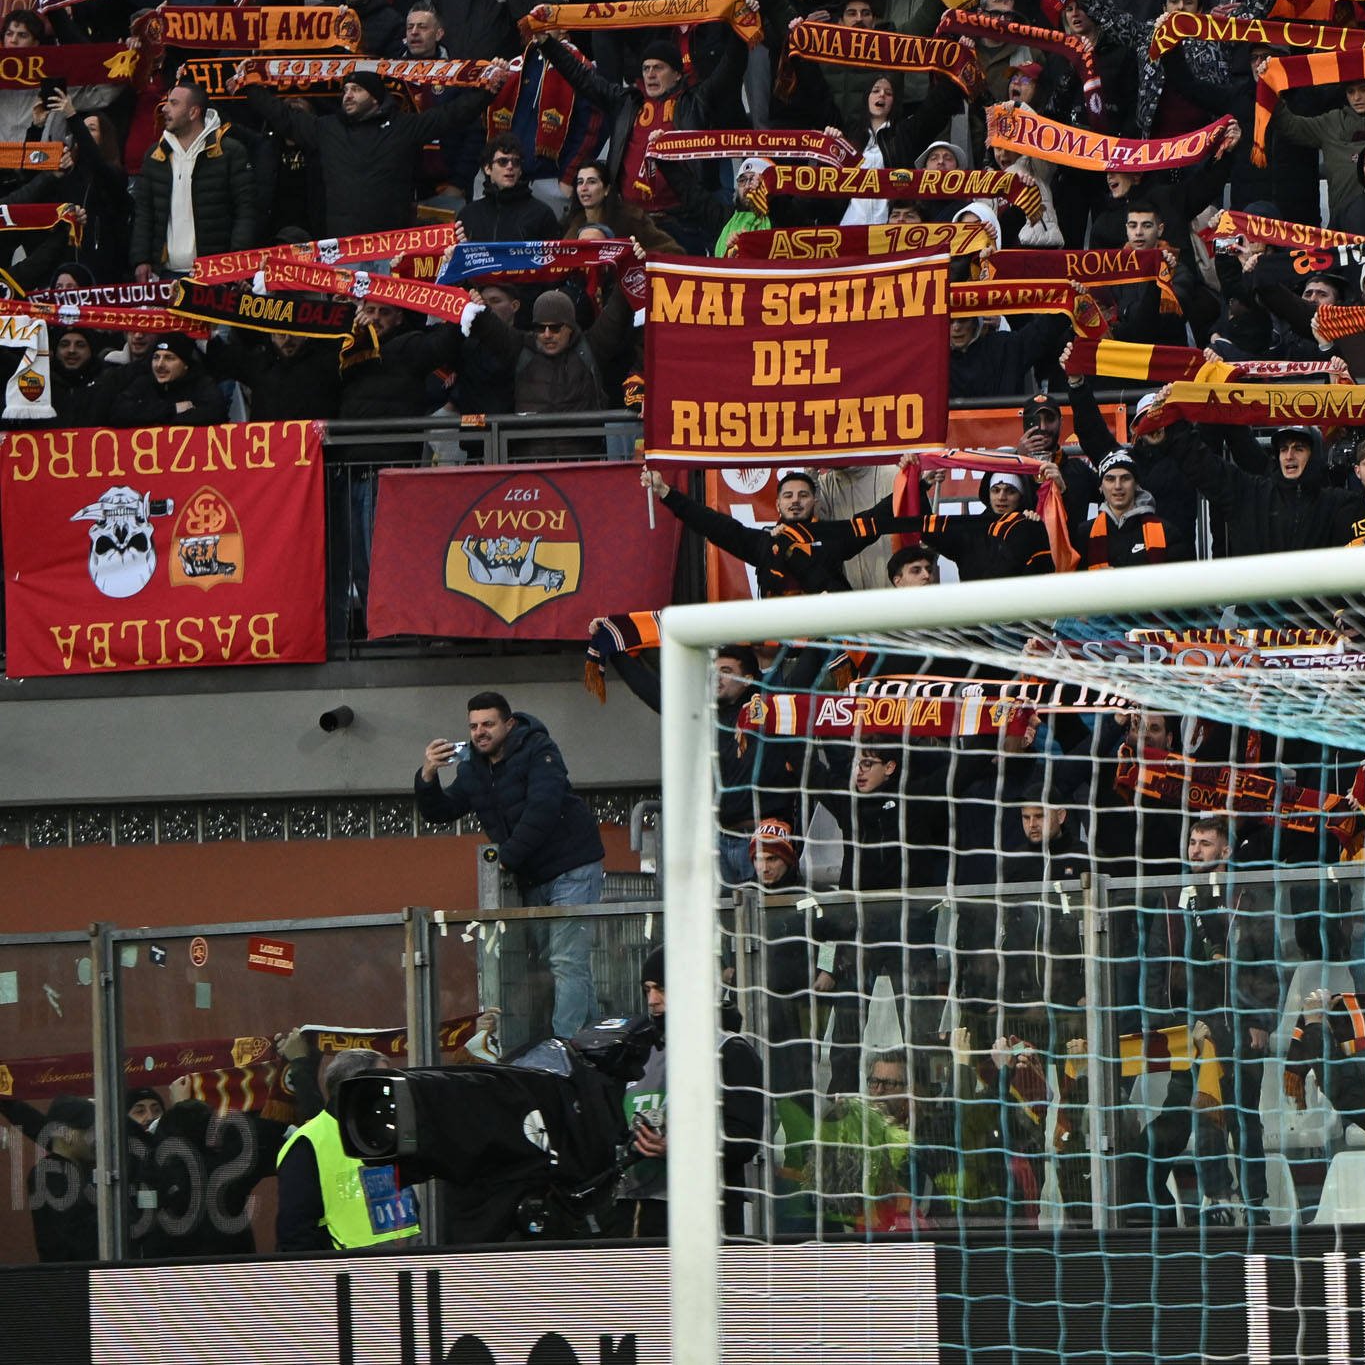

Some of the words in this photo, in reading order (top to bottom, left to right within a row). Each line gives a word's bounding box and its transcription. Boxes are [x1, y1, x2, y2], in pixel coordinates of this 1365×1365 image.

[165, 10, 243, 42] ROMA
[244, 8, 273, 39] TI
[278, 7, 334, 39] AMO
[584, 2, 618, 19] AS
[1155, 12, 1271, 55] ROMA
[850, 35, 882, 63] HA
[889, 38, 961, 70] VINTO
[278, 60, 353, 79] FORZA
[376, 61, 454, 83] ROMA
[721, 133, 756, 148] Ultrà
[759, 132, 794, 148] Curva
[797, 134, 824, 150] Sud
[1021, 114, 1111, 154] ROMA
[1126, 127, 1207, 165] AMO
[776, 163, 880, 193] FORZA
[917, 168, 1013, 195] ROMA
[768, 227, 842, 260] ASR
[1246, 212, 1283, 238] NUN
[1285, 219, 1316, 243] SE
[193, 248, 291, 285] BASILEA
[1065, 250, 1141, 278] ROMA
[238, 294, 294, 321] ROMA
[264, 267, 334, 291] BASILEA
[373, 283, 467, 315] LENZBURG
[650, 276, 745, 324] MAI
[760, 269, 950, 325] SCHIAVI
[980, 286, 1069, 309] PARMA
[751, 338, 842, 387] DEL
[670, 392, 926, 448] RISULTATO
[10, 419, 313, 483] LENZBURG
[504, 488, 541, 502] 1927
[475, 509, 566, 531] ROMA
[49, 612, 281, 669] BASILEA
